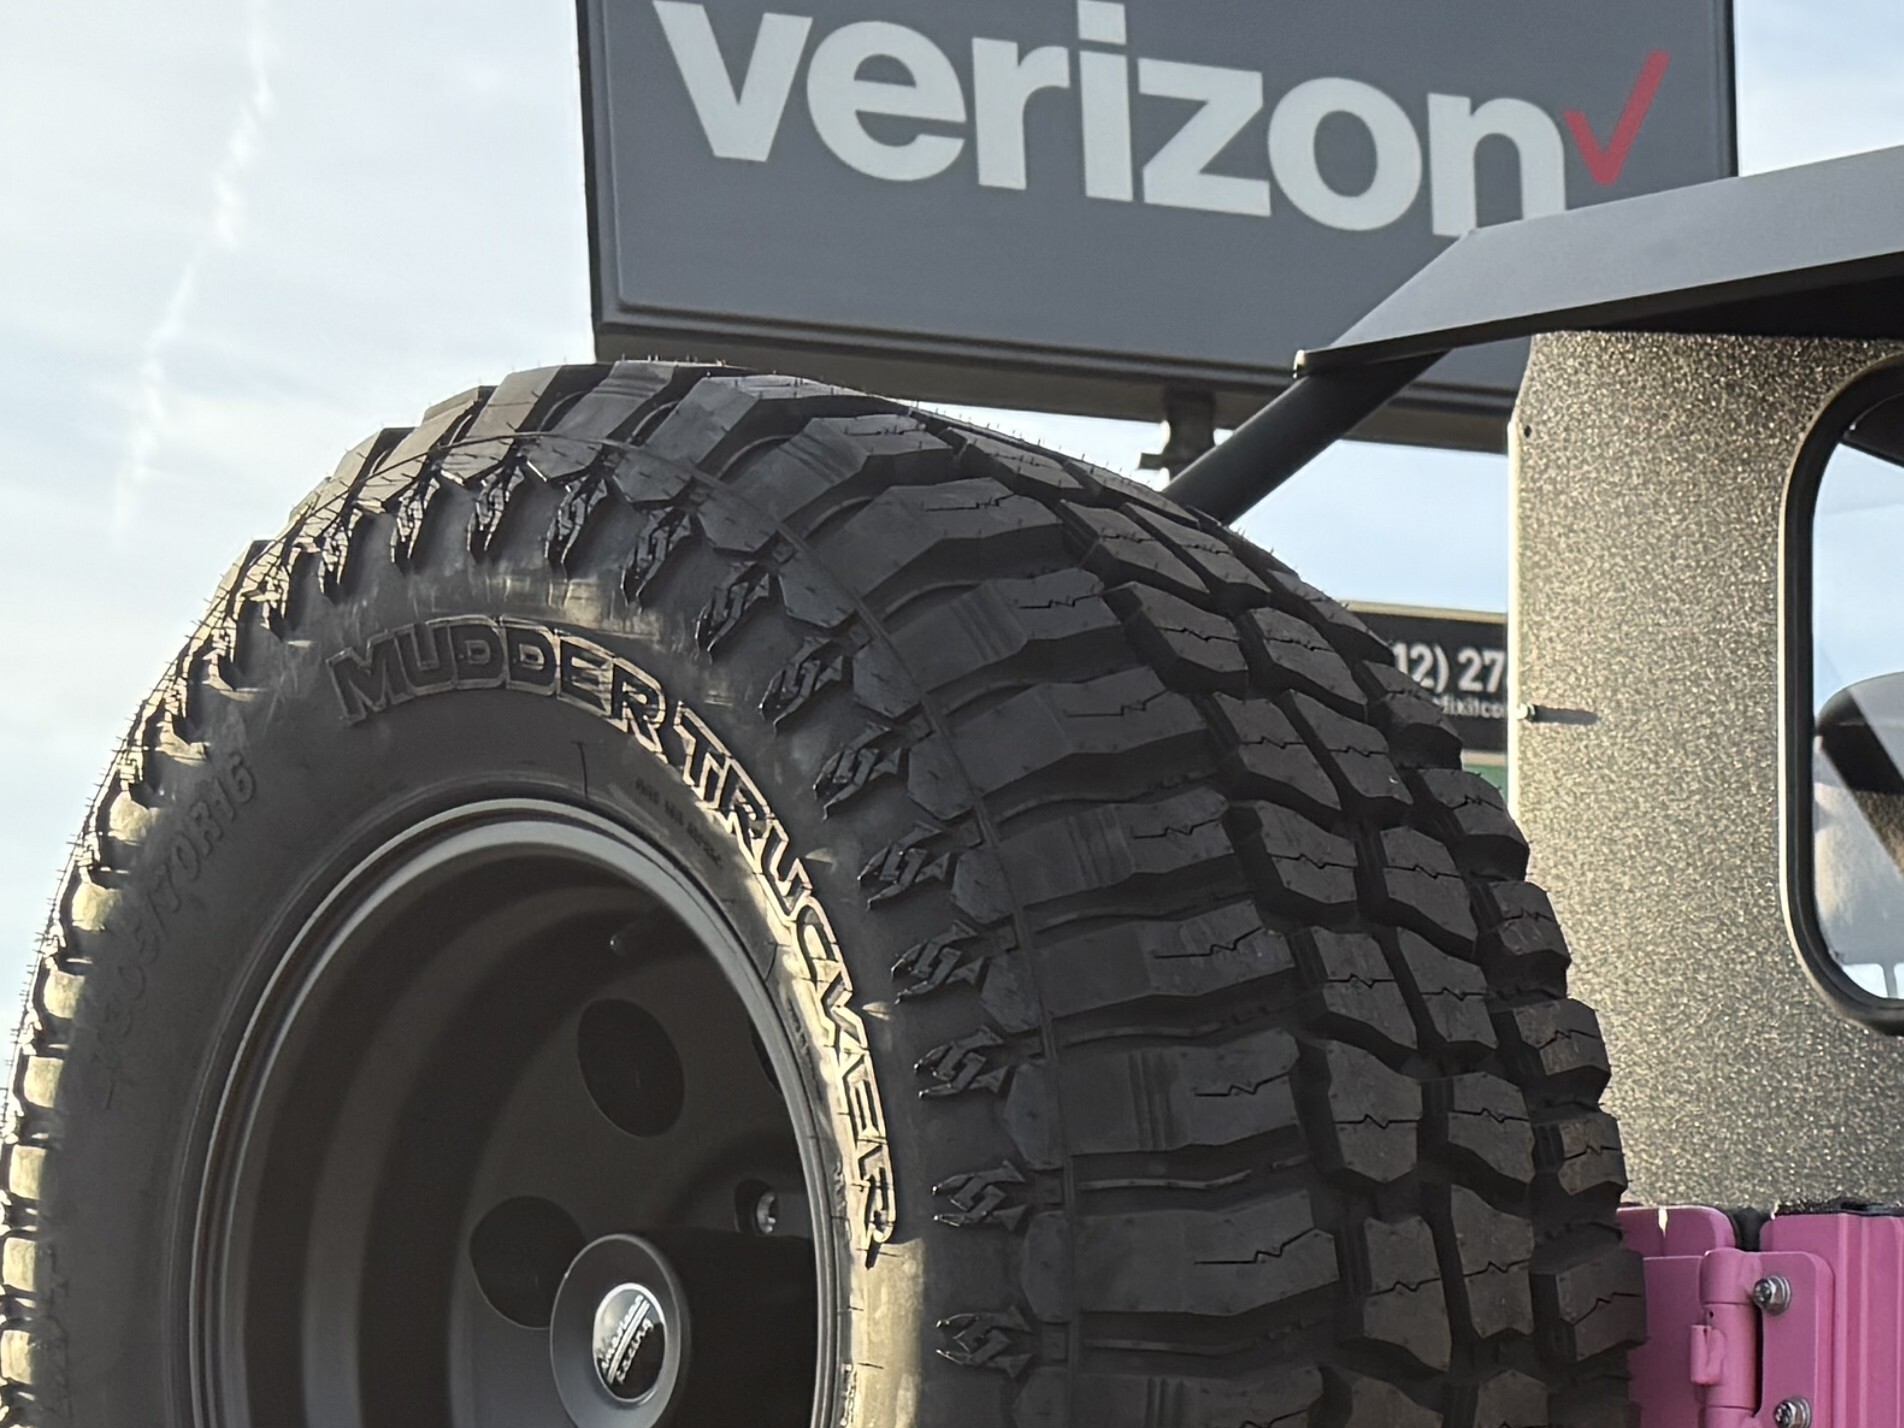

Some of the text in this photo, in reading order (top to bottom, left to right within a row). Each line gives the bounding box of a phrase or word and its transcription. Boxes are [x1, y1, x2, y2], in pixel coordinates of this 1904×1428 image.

[652, 0, 1566, 238] verizon
[326, 614, 898, 1265] MUDDER TRUCKER
